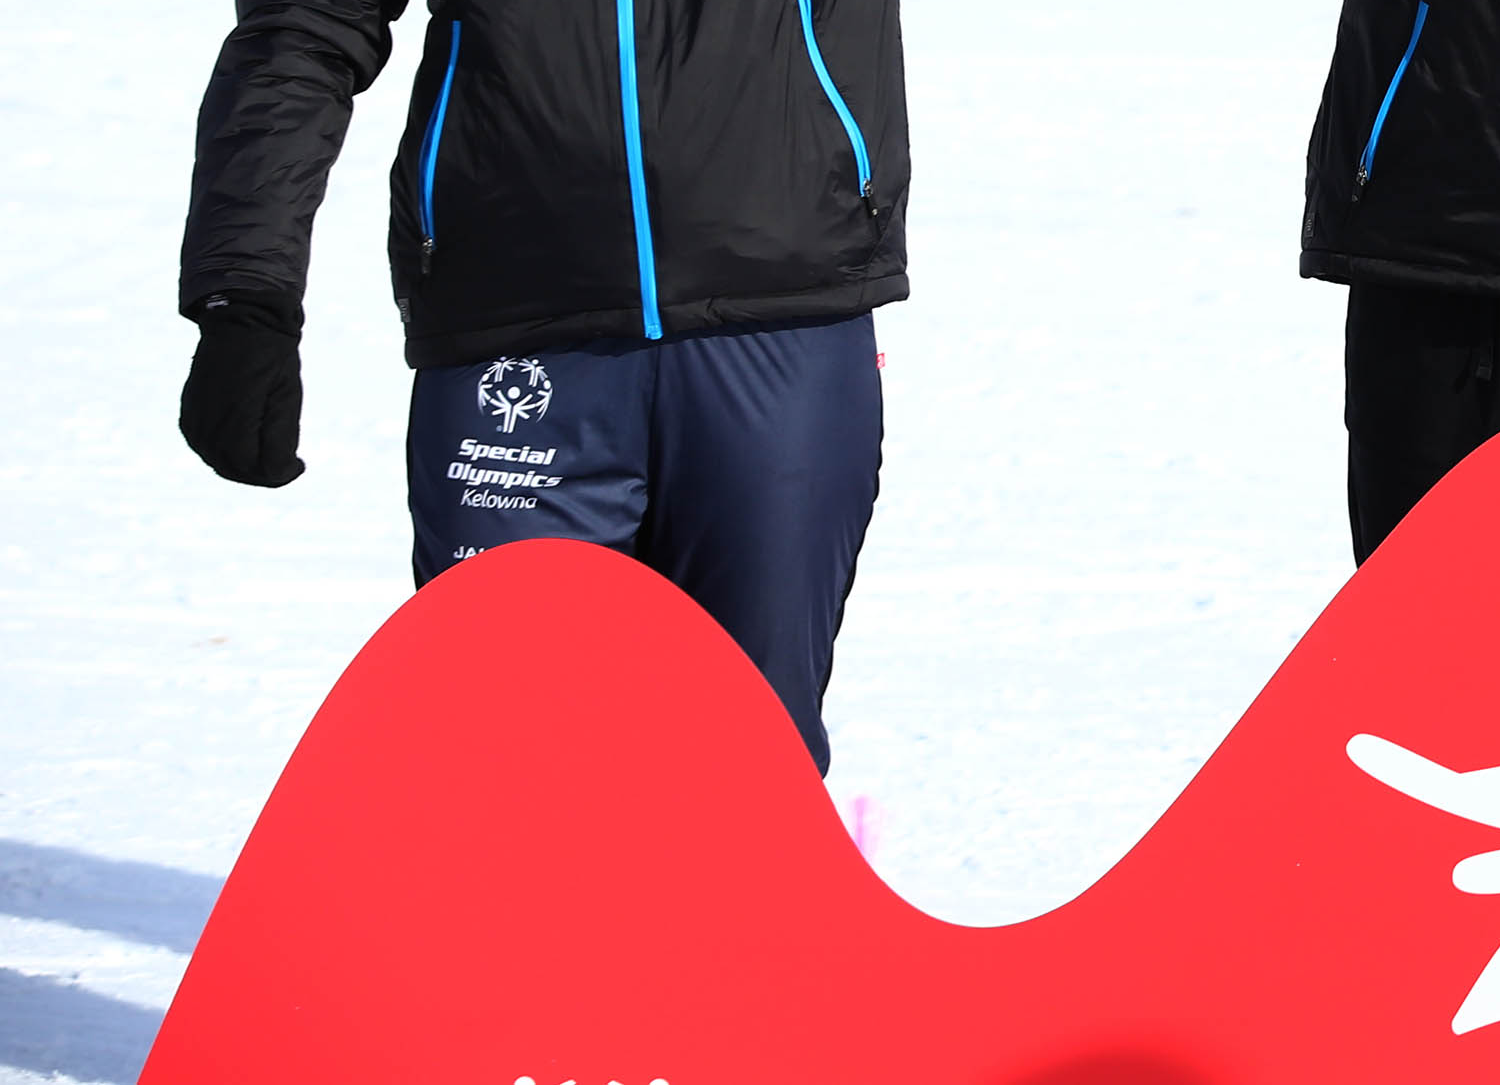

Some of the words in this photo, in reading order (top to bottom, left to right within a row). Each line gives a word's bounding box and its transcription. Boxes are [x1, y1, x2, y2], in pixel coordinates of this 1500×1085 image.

[458, 439, 557, 466] Special
[447, 462, 564, 489] Olympics
[460, 488, 538, 509] Kelowna
[453, 545, 485, 559] JA
